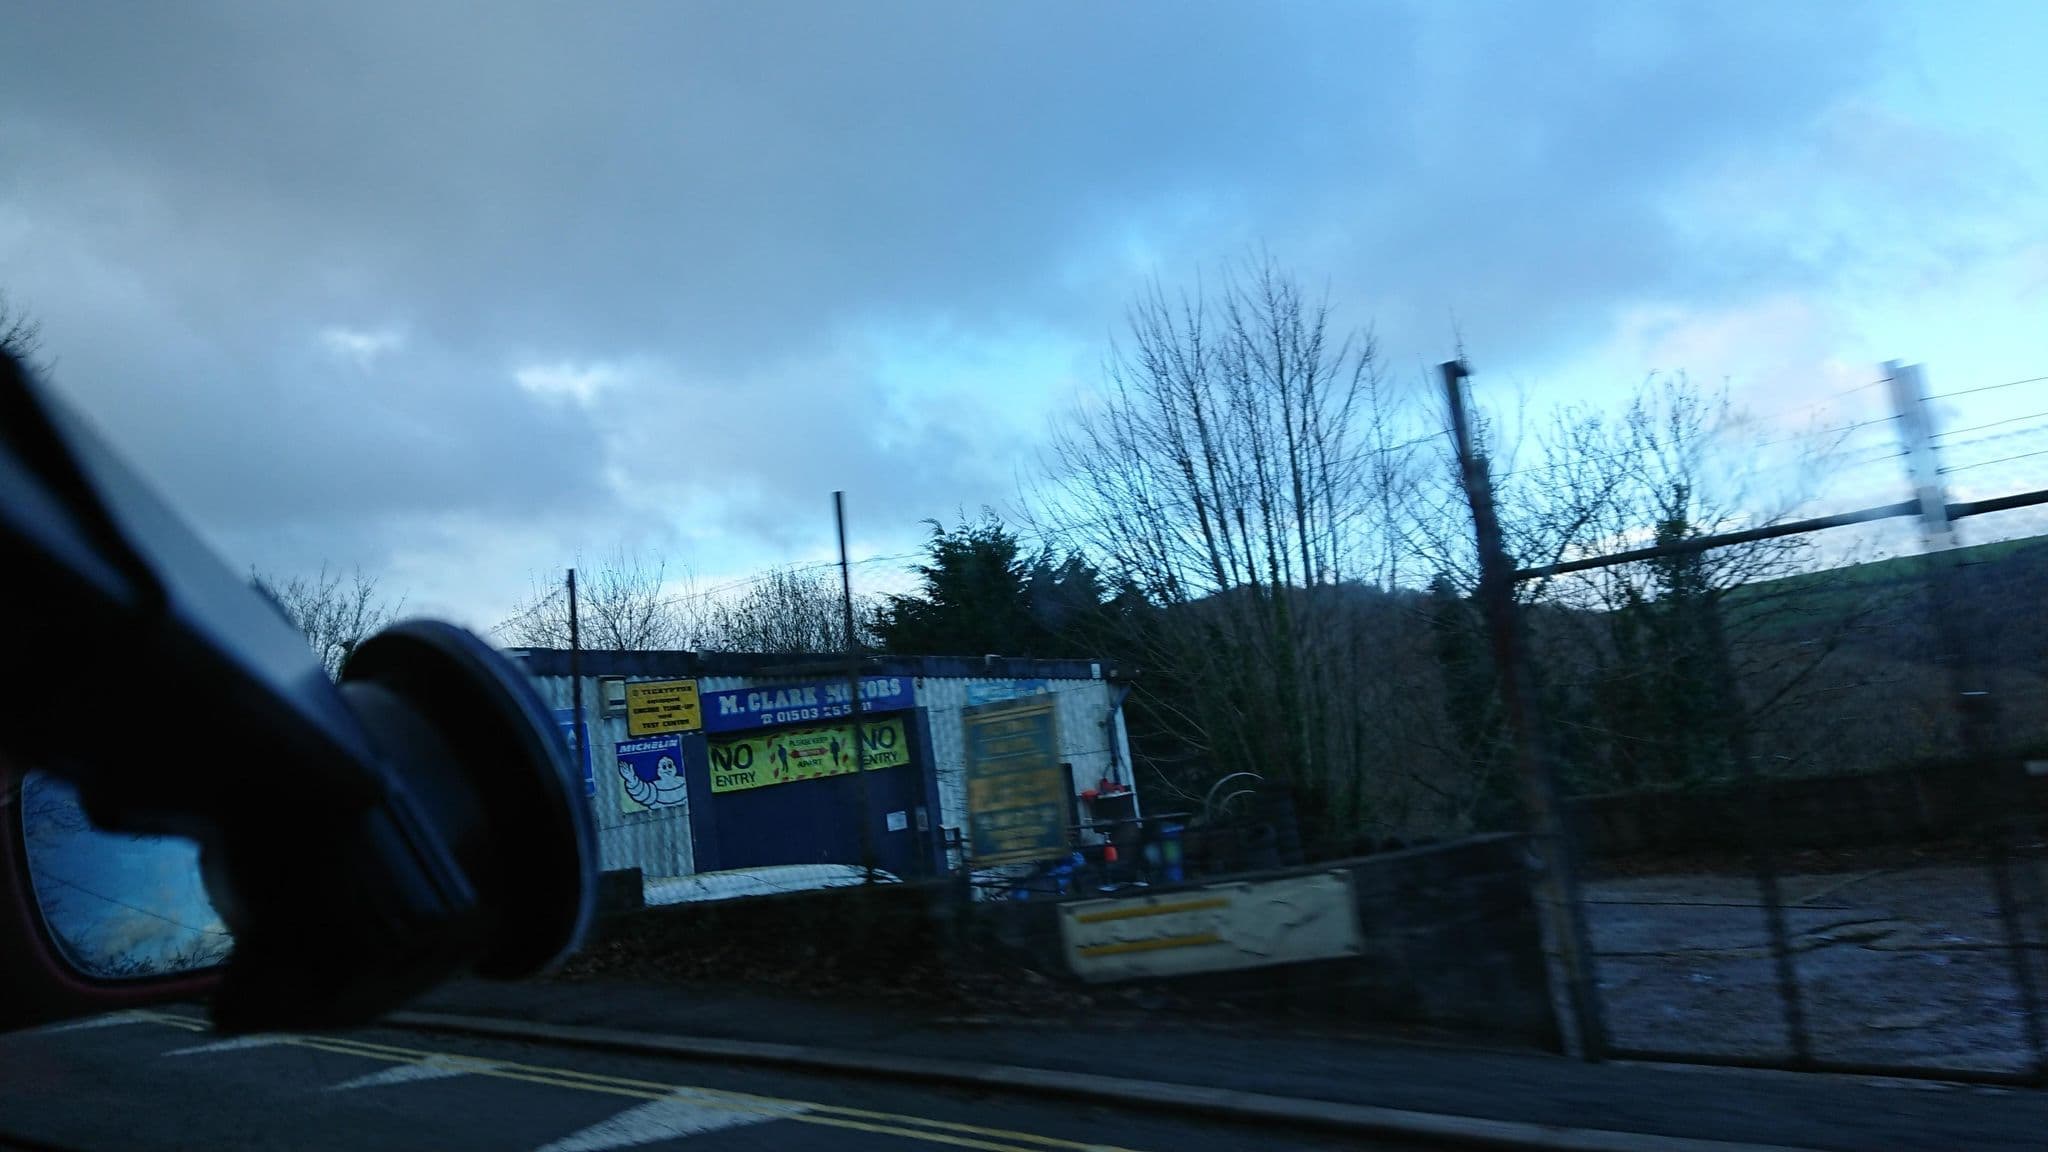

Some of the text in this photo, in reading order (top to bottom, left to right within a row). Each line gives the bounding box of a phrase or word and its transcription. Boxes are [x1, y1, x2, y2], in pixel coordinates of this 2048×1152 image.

[824, 678, 902, 703] MOTORS
[777, 707, 819, 723] 01503
[642, 721, 659, 729] TEST
[789, 738, 811, 747] PLEASE
[862, 726, 896, 750] NO
[619, 739, 678, 753] MICHELIN
[711, 743, 753, 772] NO
[797, 758, 823, 769] APART
[863, 751, 898, 765] ENTRY
[715, 771, 757, 787] ENTRY
